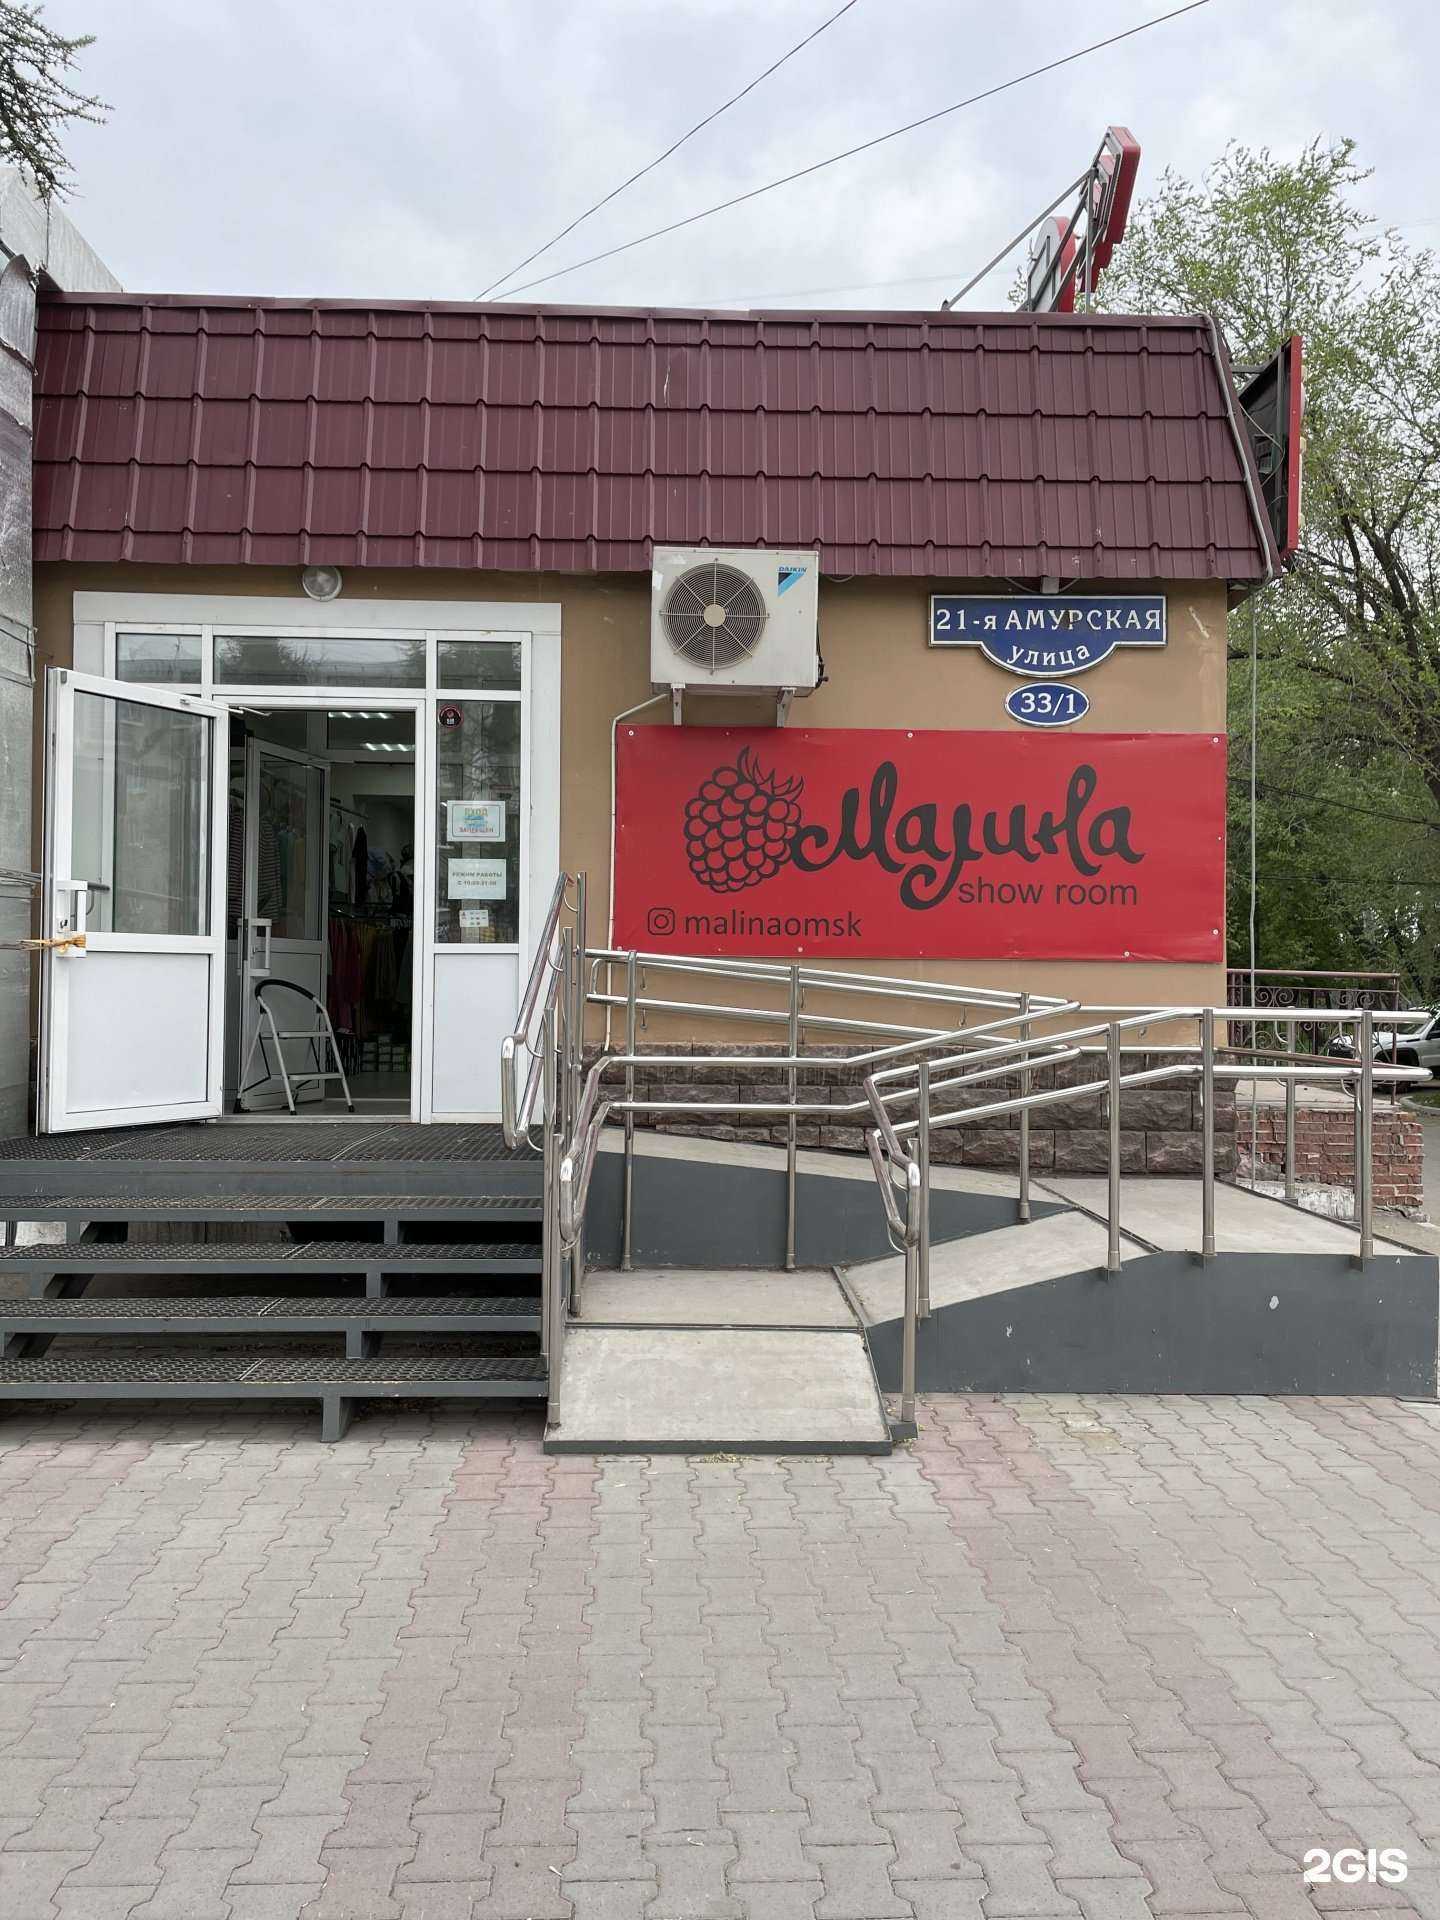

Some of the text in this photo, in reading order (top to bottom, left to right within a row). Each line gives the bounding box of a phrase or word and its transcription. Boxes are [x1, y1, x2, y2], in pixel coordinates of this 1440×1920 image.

[936, 608, 1161, 631] 21-я АМУРСКАЯ
[1007, 644, 1090, 666] улица
[1020, 692, 1076, 716] 33/1
[792, 761, 1145, 910] Малина
[957, 877, 1138, 905] show room
[685, 909, 862, 937] malinaomsk
